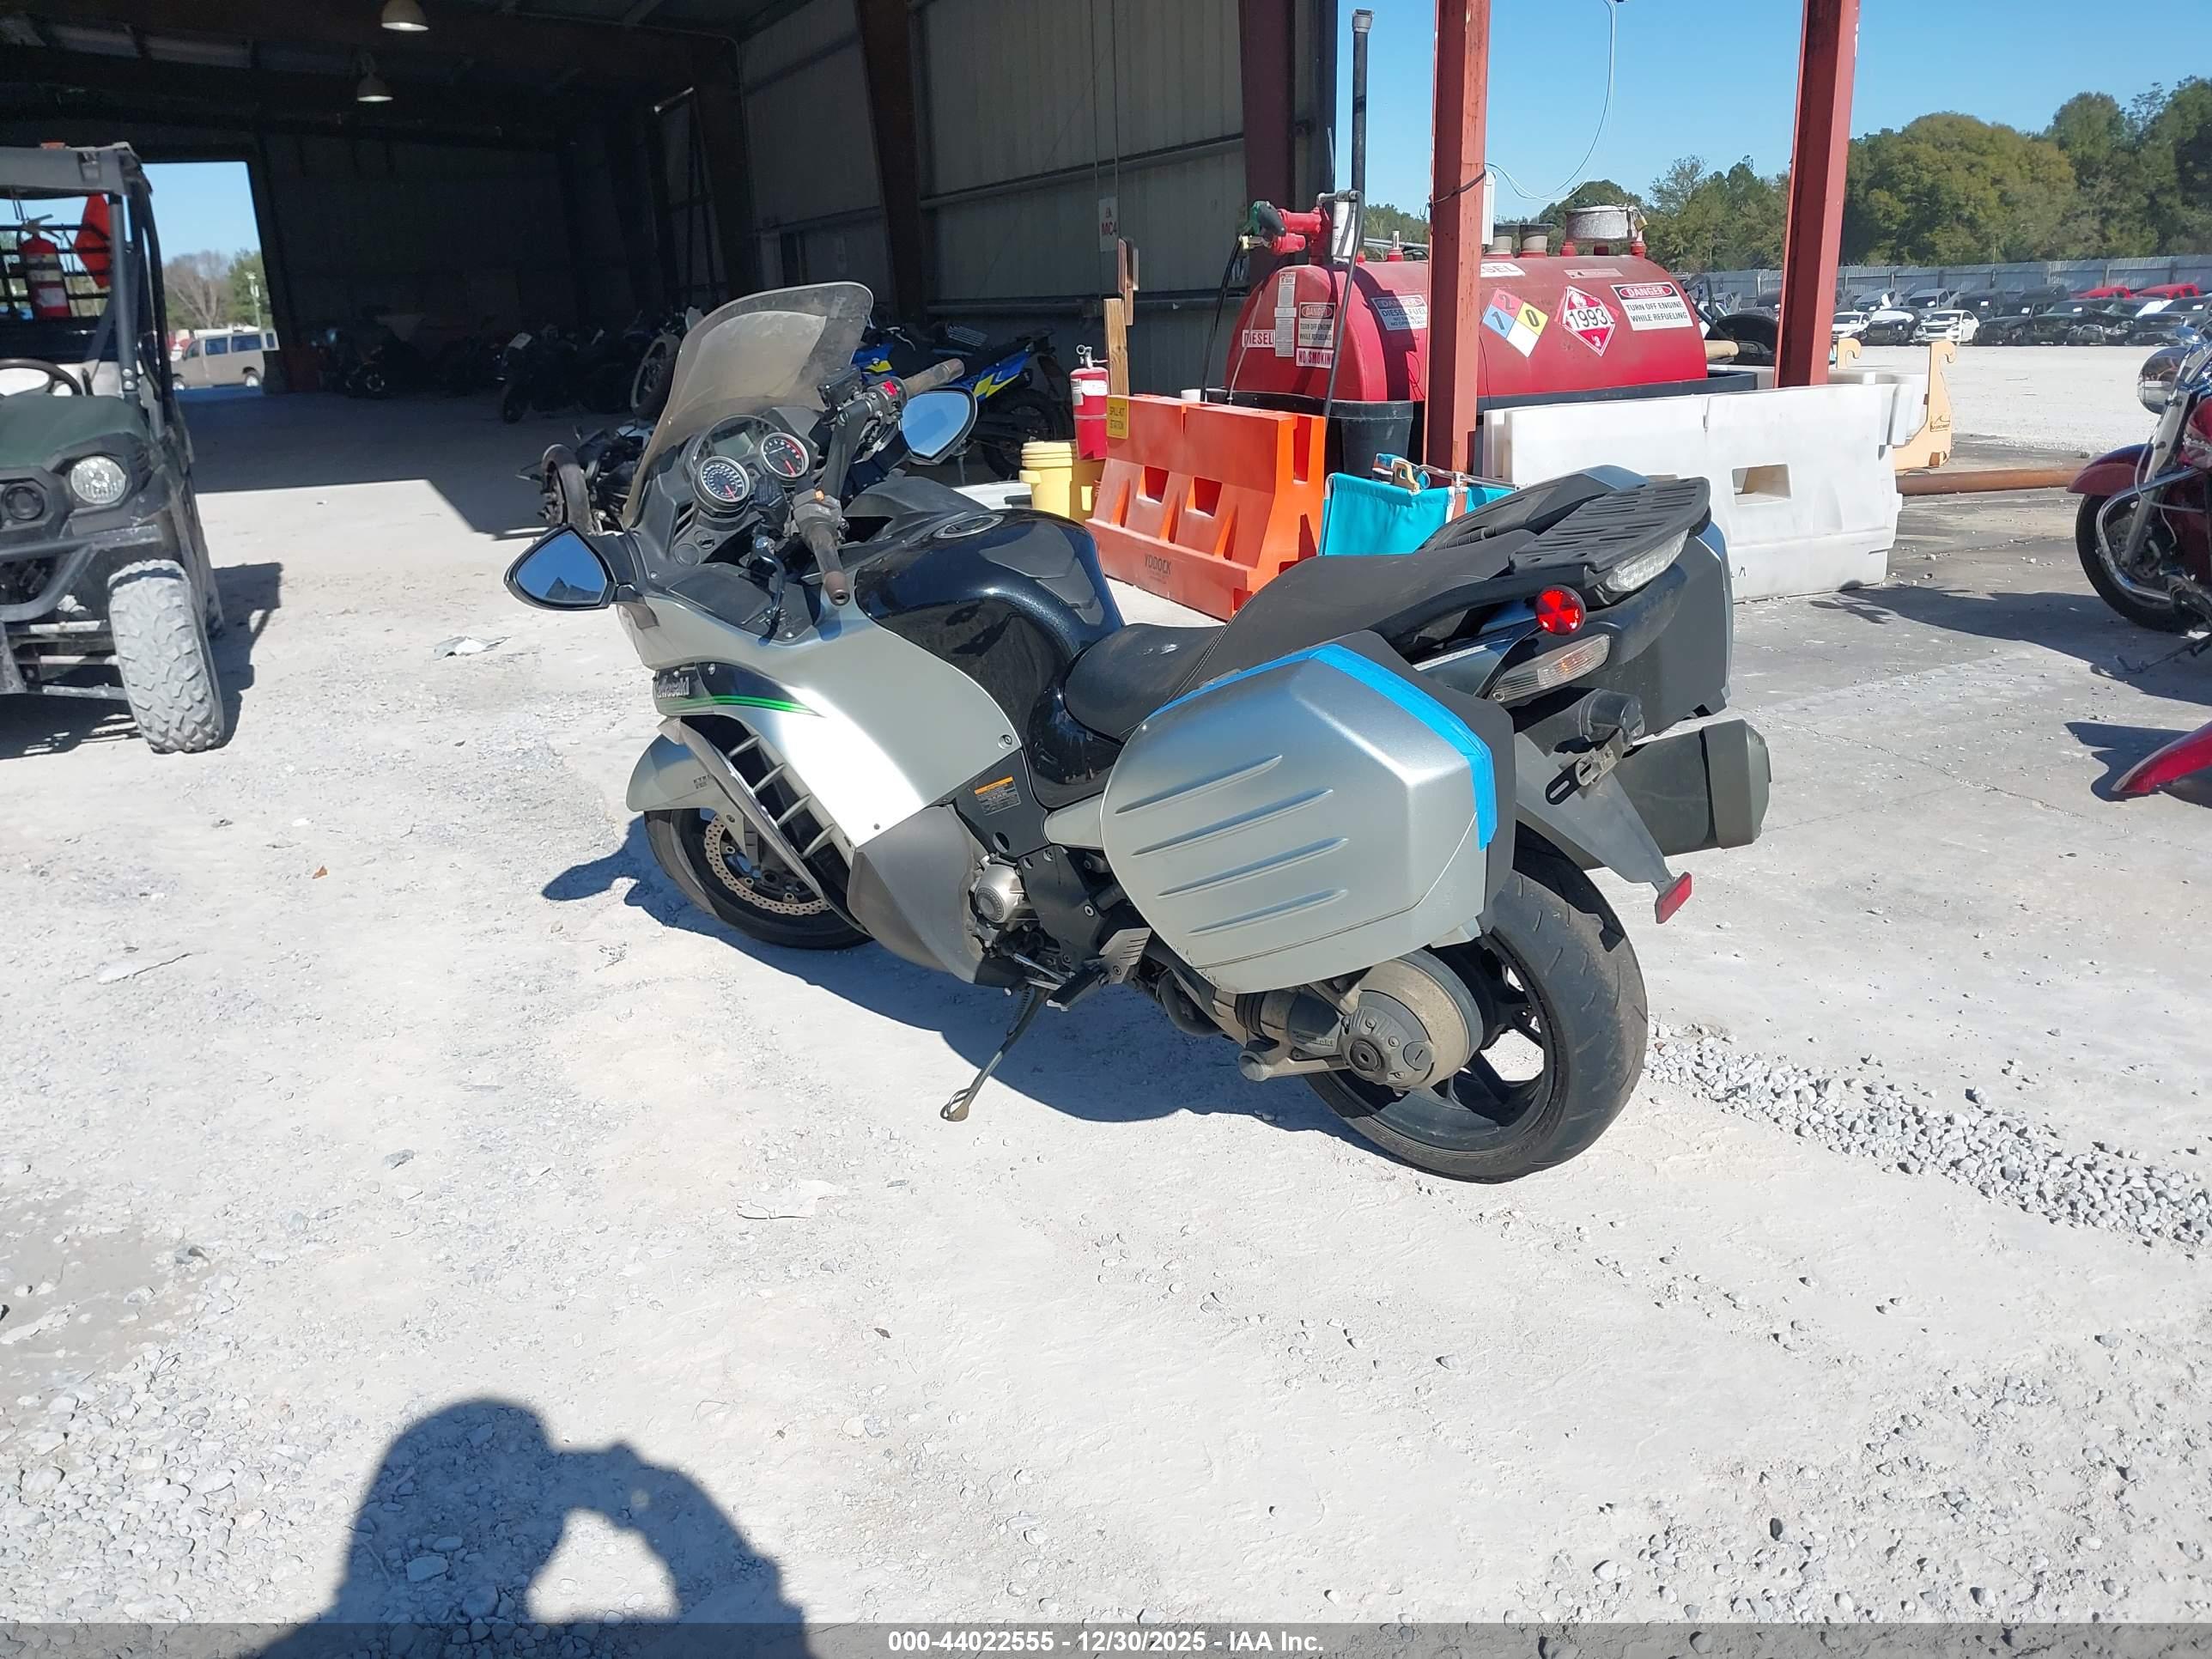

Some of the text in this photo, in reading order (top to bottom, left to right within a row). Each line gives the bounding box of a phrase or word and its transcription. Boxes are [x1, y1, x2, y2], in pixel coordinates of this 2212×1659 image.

[1626, 286, 1665, 297] DANGER
[1498, 294, 1515, 310] 2
[1658, 301, 1683, 309] ENGINE
[1381, 308, 1408, 317] DIESEL
[1569, 307, 1608, 329] 1993
[1631, 311, 1688, 323] WHILE REFUELING
[1492, 309, 1540, 331] 1 0
[1244, 332, 1273, 345] DIESEL
[1298, 349, 1333, 366] NO SMOKIN
